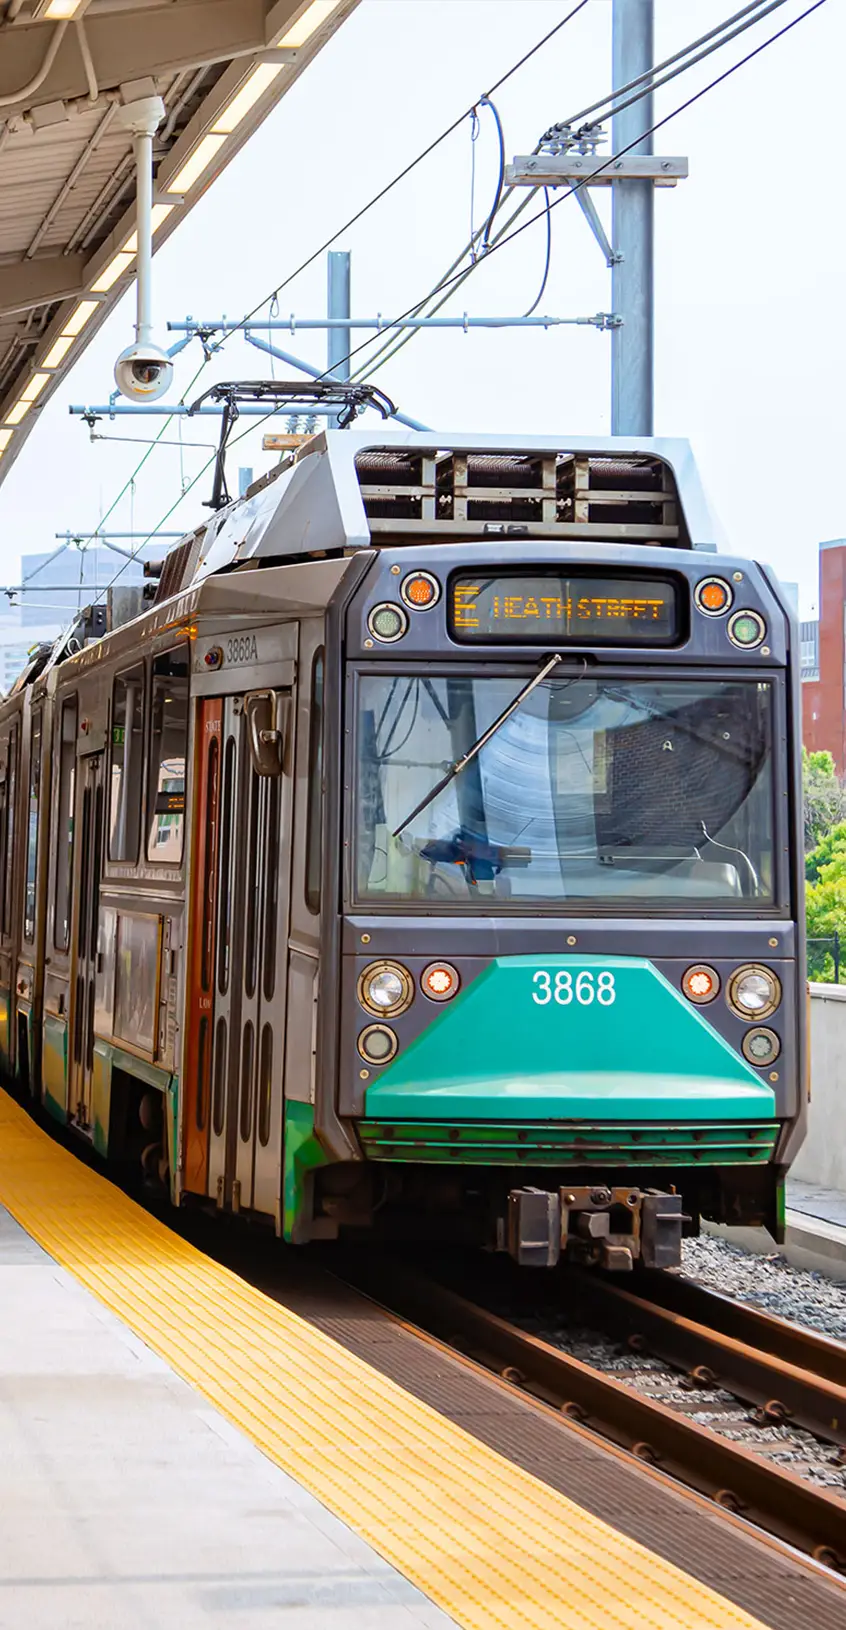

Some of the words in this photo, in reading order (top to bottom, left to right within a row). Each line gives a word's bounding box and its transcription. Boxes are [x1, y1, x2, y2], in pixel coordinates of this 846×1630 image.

[454, 585, 480, 627] E
[492, 596, 572, 619] HEATH
[227, 634, 258, 663] 3868A
[531, 970, 617, 1006] 3868
